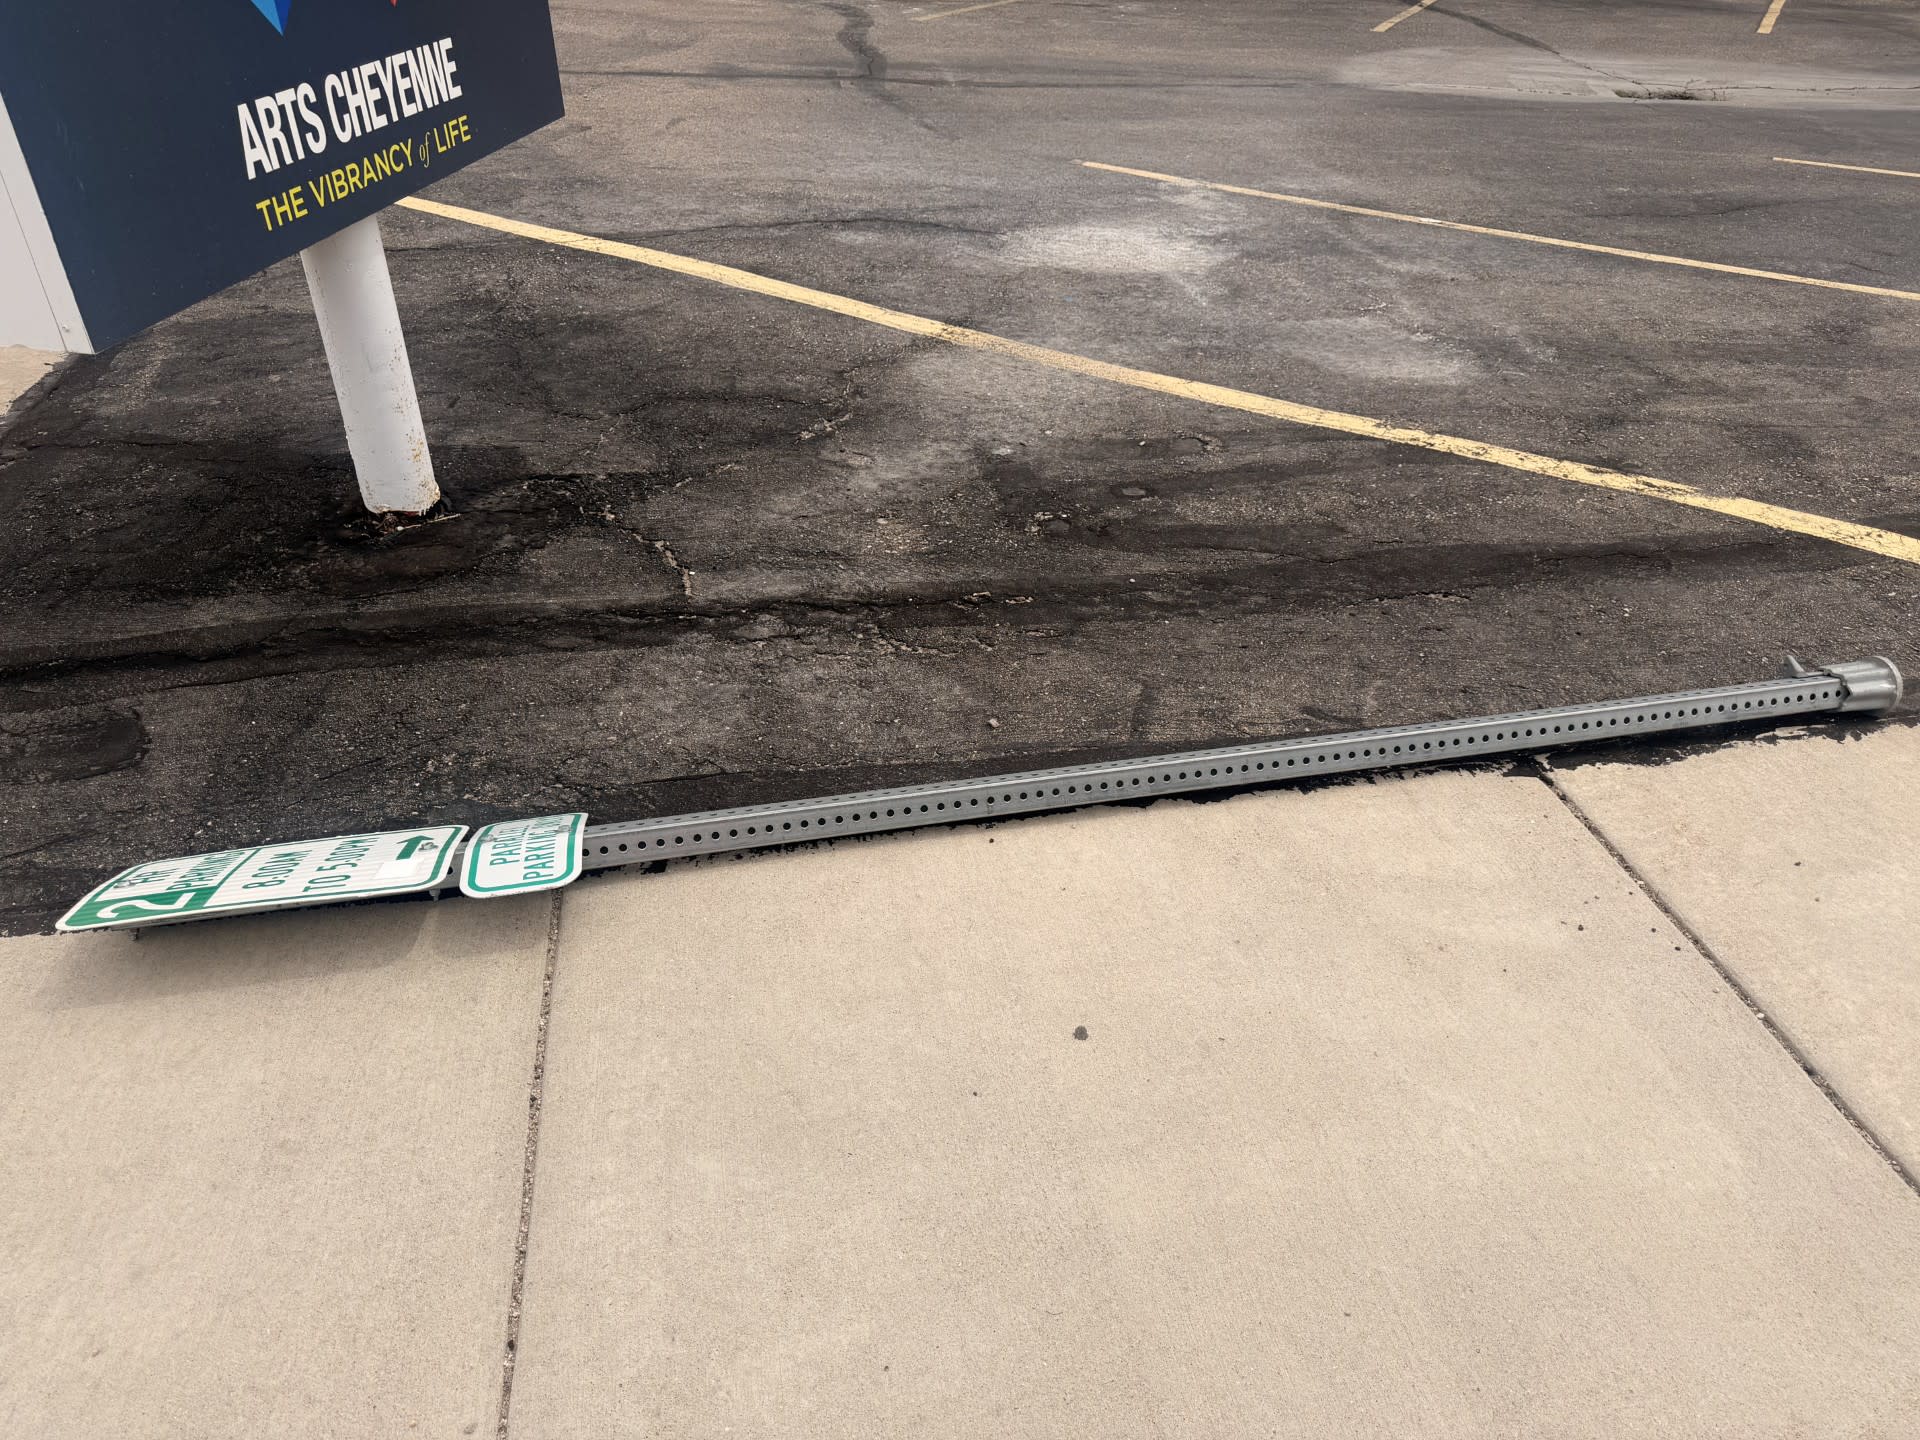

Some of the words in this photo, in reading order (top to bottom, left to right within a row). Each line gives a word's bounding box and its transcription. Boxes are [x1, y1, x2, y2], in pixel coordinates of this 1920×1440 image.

[237, 82, 327, 180] ARTS
[324, 37, 463, 143] CHEYENNE
[255, 186, 308, 232] THE
[308, 138, 413, 208] VIBRANCY
[419, 132, 430, 168] of
[433, 115, 472, 153] LIFE
[166, 852, 245, 890] PARKING
[242, 850, 312, 889] 8:00AM
[315, 838, 381, 872] 5:00PM
[522, 832, 557, 880] PARKING
[133, 868, 178, 883] HR
[302, 874, 351, 893] TO
[96, 892, 196, 918] 2
